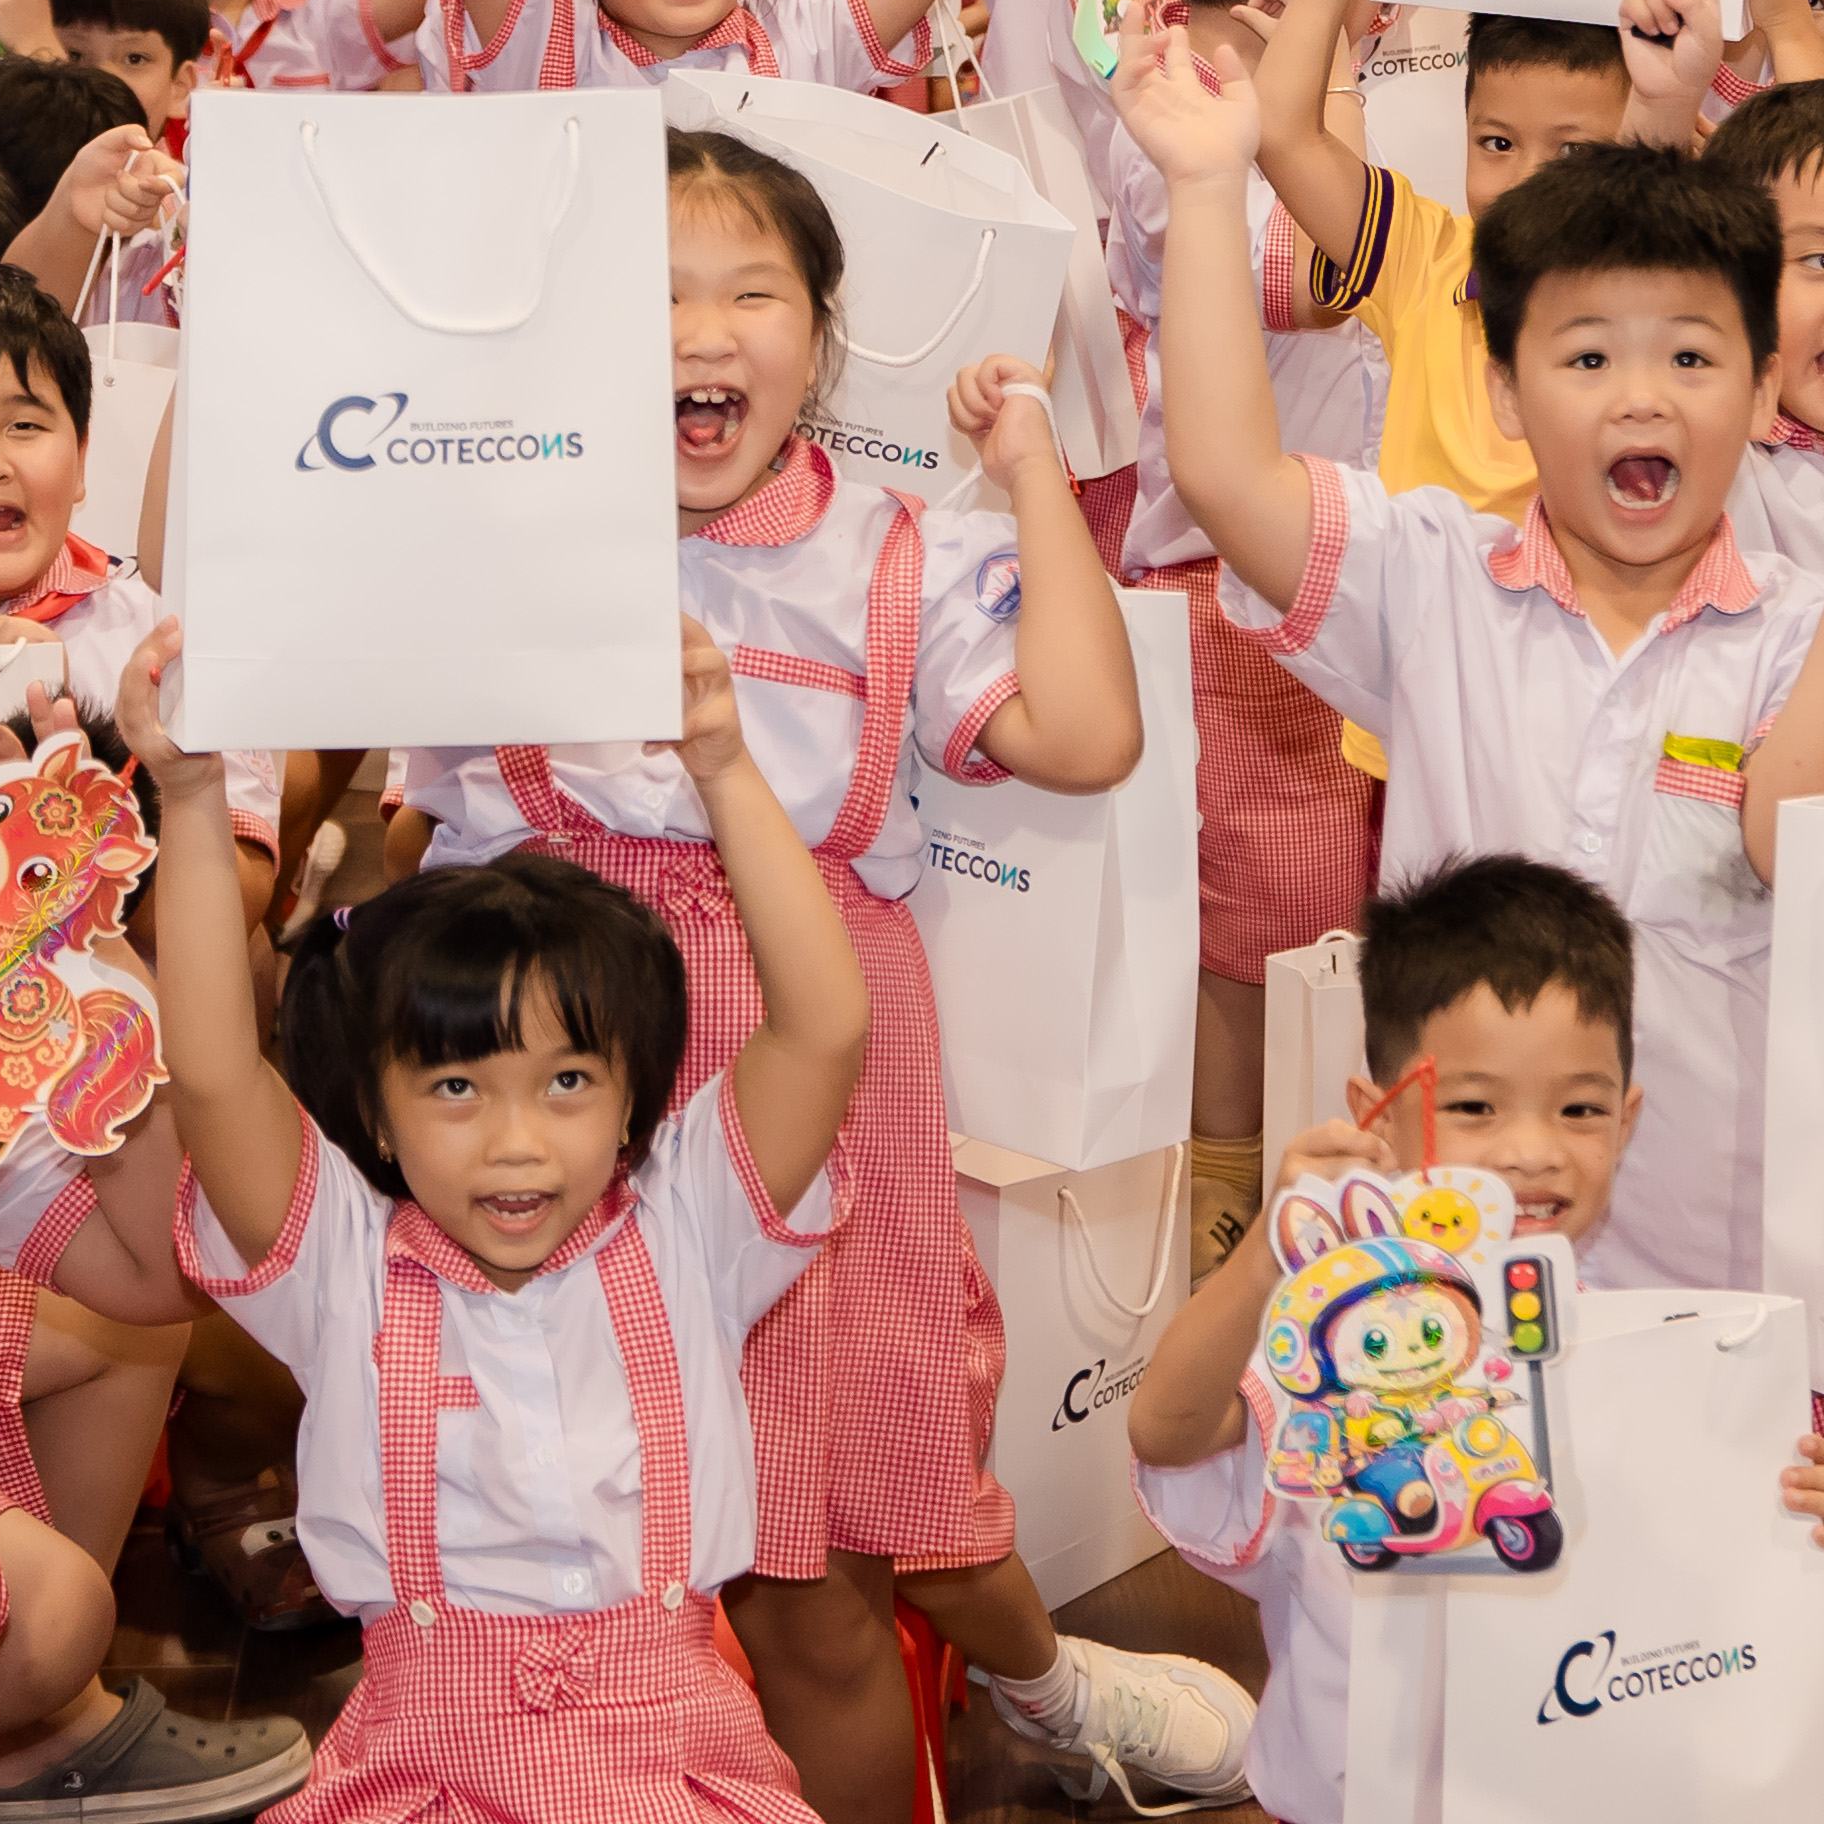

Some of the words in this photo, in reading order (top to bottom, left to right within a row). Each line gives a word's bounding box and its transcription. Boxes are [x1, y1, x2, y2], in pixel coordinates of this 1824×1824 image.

[1372, 51, 1469, 76] COTECCON
[410, 420, 463, 431] BUILDING
[467, 419, 513, 431] FUTURES
[386, 432, 583, 465] COTECCONS
[794, 422, 939, 469] OTECCONS
[932, 829, 952, 841] DING
[930, 842, 1030, 892] TECCONS
[1094, 1368, 1145, 1409] COTECC
[1609, 1644, 1757, 1702] COTECCONS
